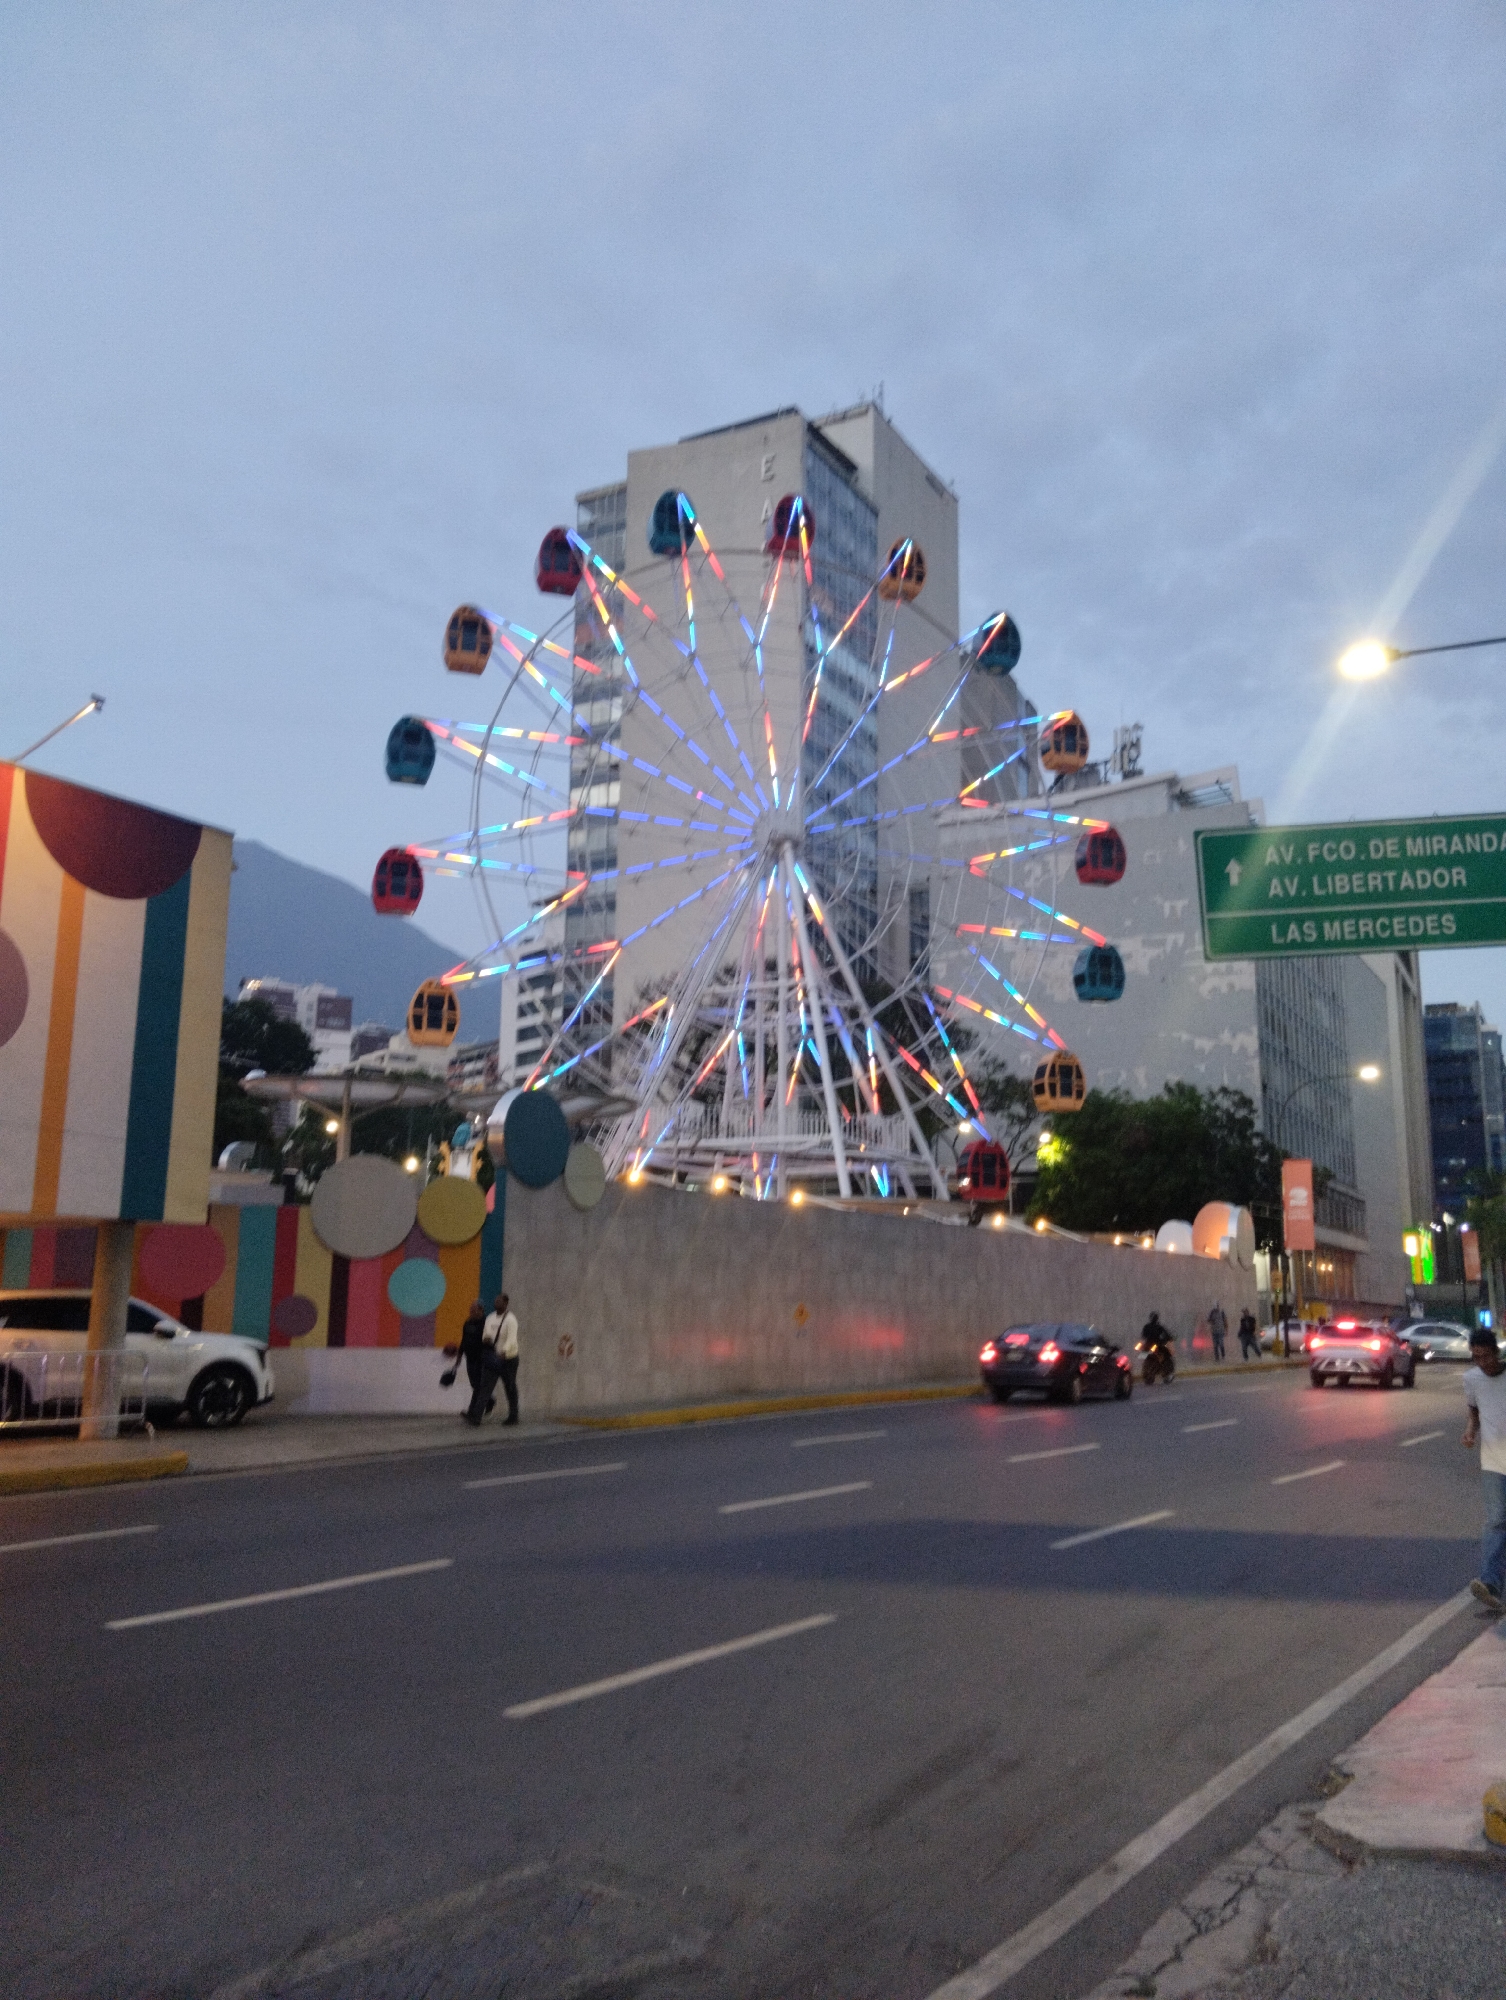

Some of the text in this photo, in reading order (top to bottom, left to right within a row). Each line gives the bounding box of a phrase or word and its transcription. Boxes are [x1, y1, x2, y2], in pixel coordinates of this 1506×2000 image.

[1264, 845, 1302, 866] AV.
[1369, 838, 1400, 860] DE
[1268, 866, 1468, 898] AV. LIBERTADOR
[1271, 914, 1457, 945] LAS MERCEDES
